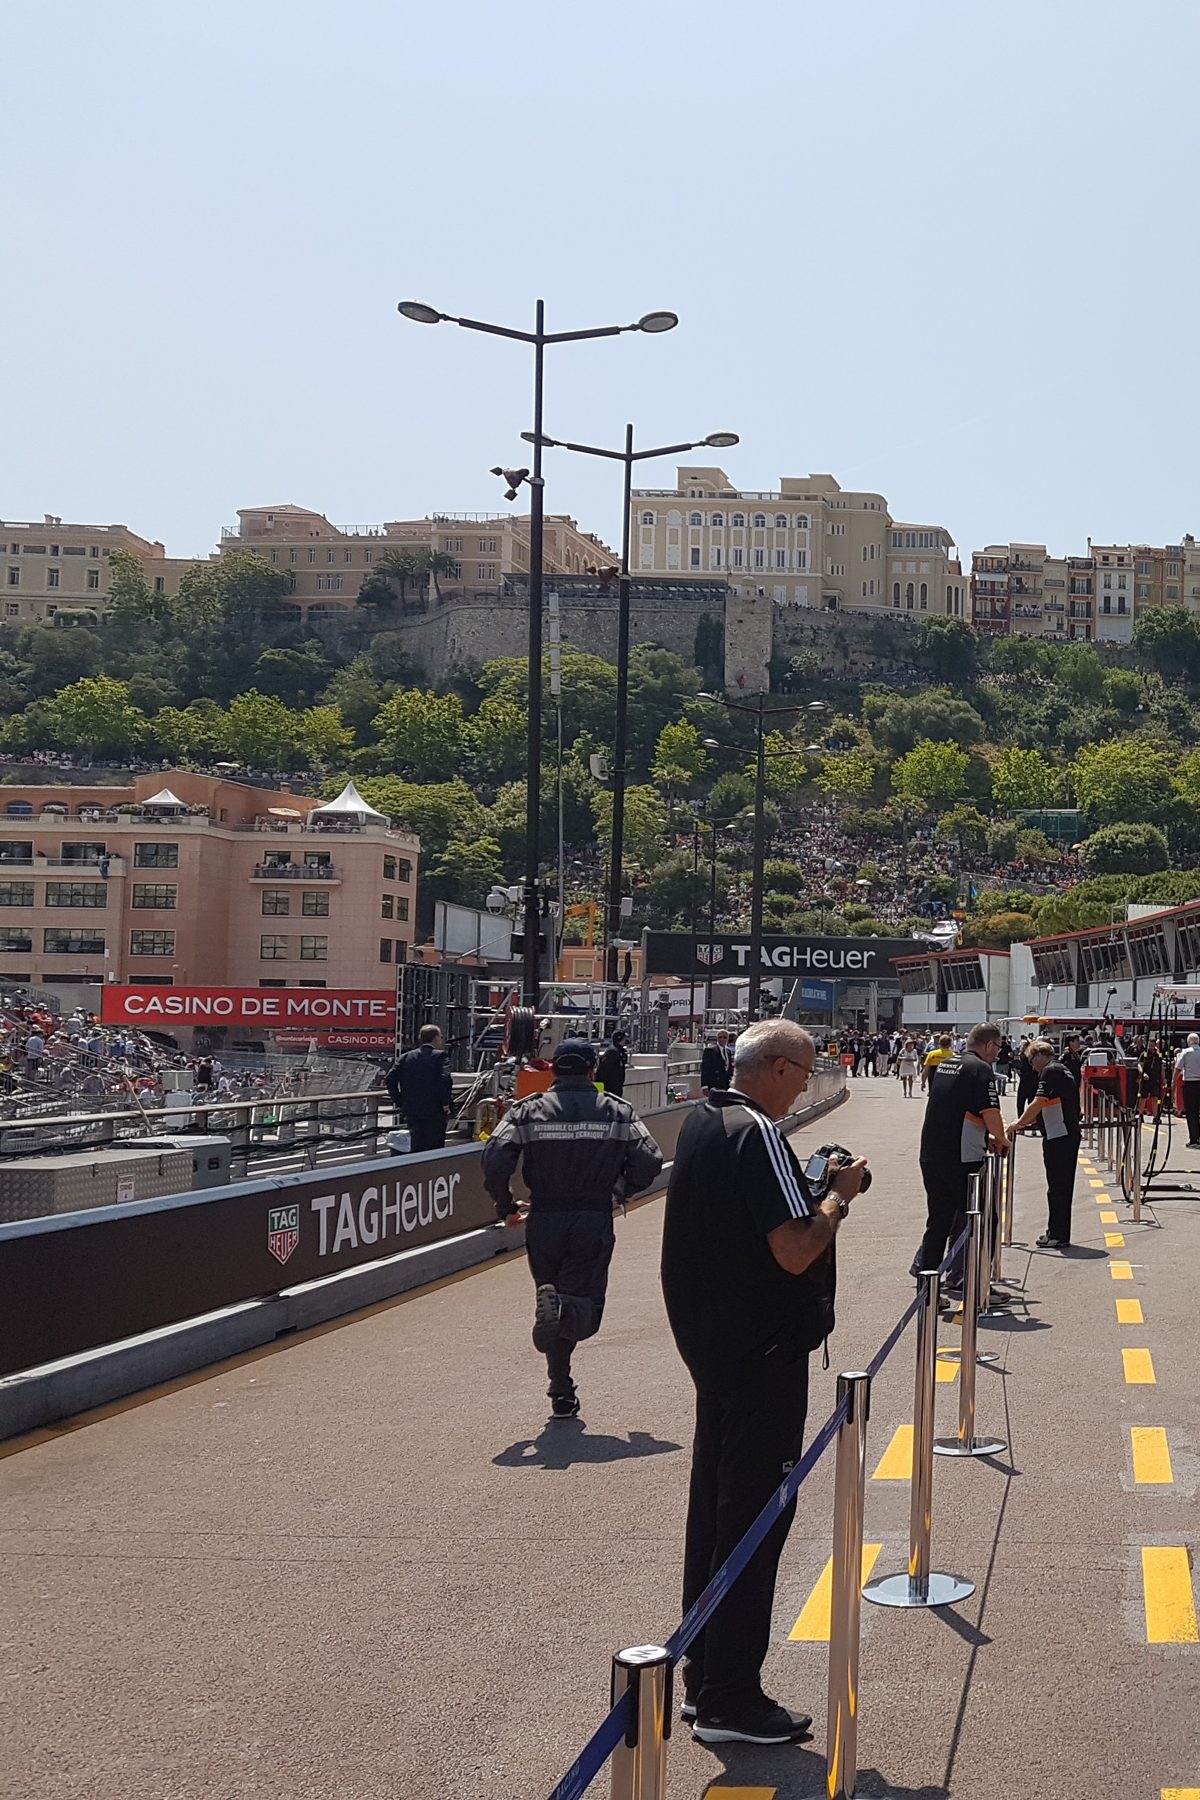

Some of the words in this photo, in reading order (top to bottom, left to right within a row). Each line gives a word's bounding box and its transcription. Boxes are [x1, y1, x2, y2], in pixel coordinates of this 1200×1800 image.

[124, 995, 234, 1016] CASINO
[241, 998, 280, 1016] DE
[327, 1035, 368, 1044] CASINO
[369, 1036, 384, 1044] DE
[272, 1208, 297, 1230] TAG
[270, 1231, 298, 1260] HEUER
